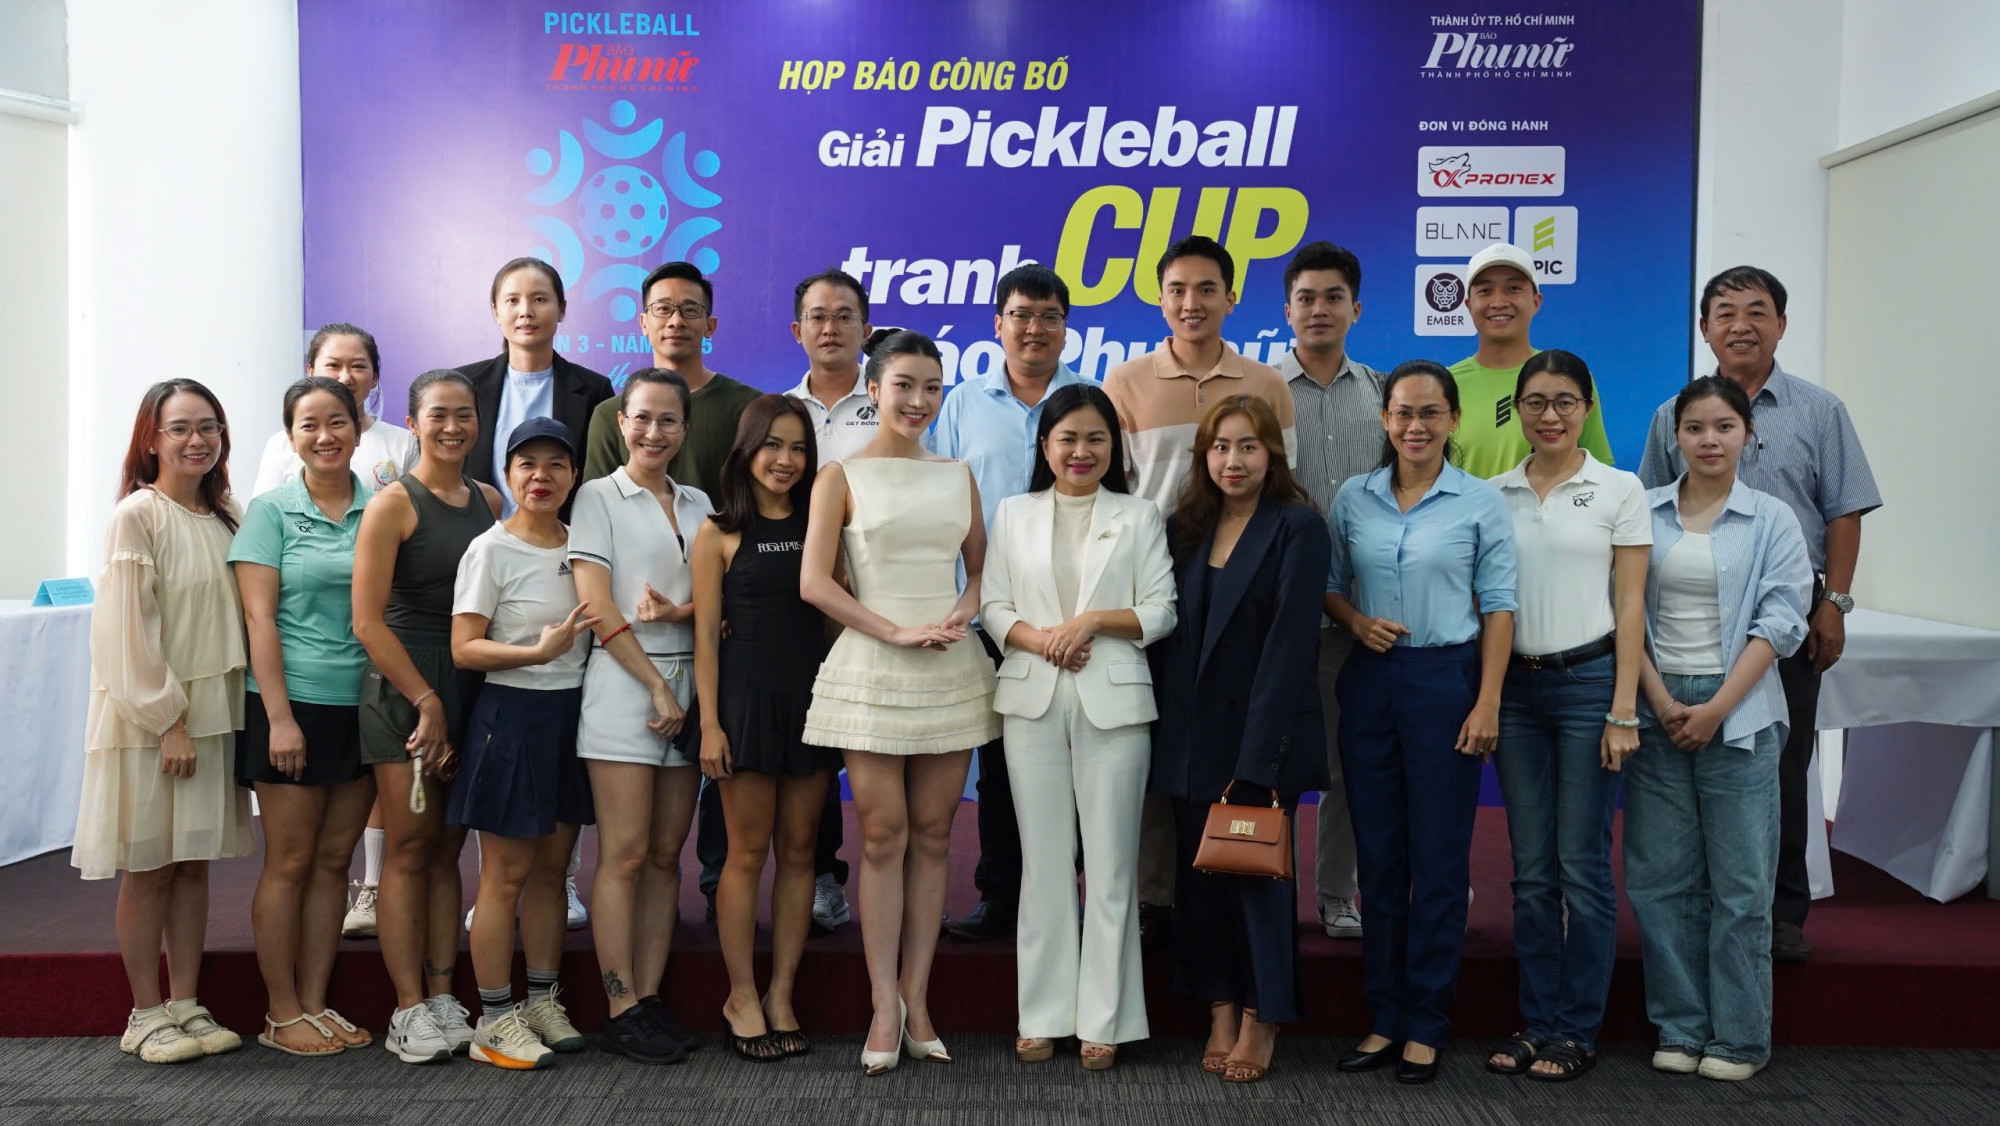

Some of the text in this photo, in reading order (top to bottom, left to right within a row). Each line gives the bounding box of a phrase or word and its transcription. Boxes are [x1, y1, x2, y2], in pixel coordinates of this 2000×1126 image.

[544, 12, 700, 36] PICKLEBALL
[1430, 13, 1575, 26] THÀNH ỦY TP. HỒ CHÍ MINH
[1479, 32, 1498, 40] BÁO
[778, 56, 1070, 95] HỌP BÁO CÔNG BỐ
[1418, 119, 1549, 133] ĐƠN VỊ ĐỒNG HÀNH
[817, 105, 1300, 169] Giải Pickleball
[1054, 184, 1310, 307] CUP
[1533, 260, 1563, 275] PIC
[1426, 315, 1465, 326] EMBER
[577, 335, 590, 352] 3
